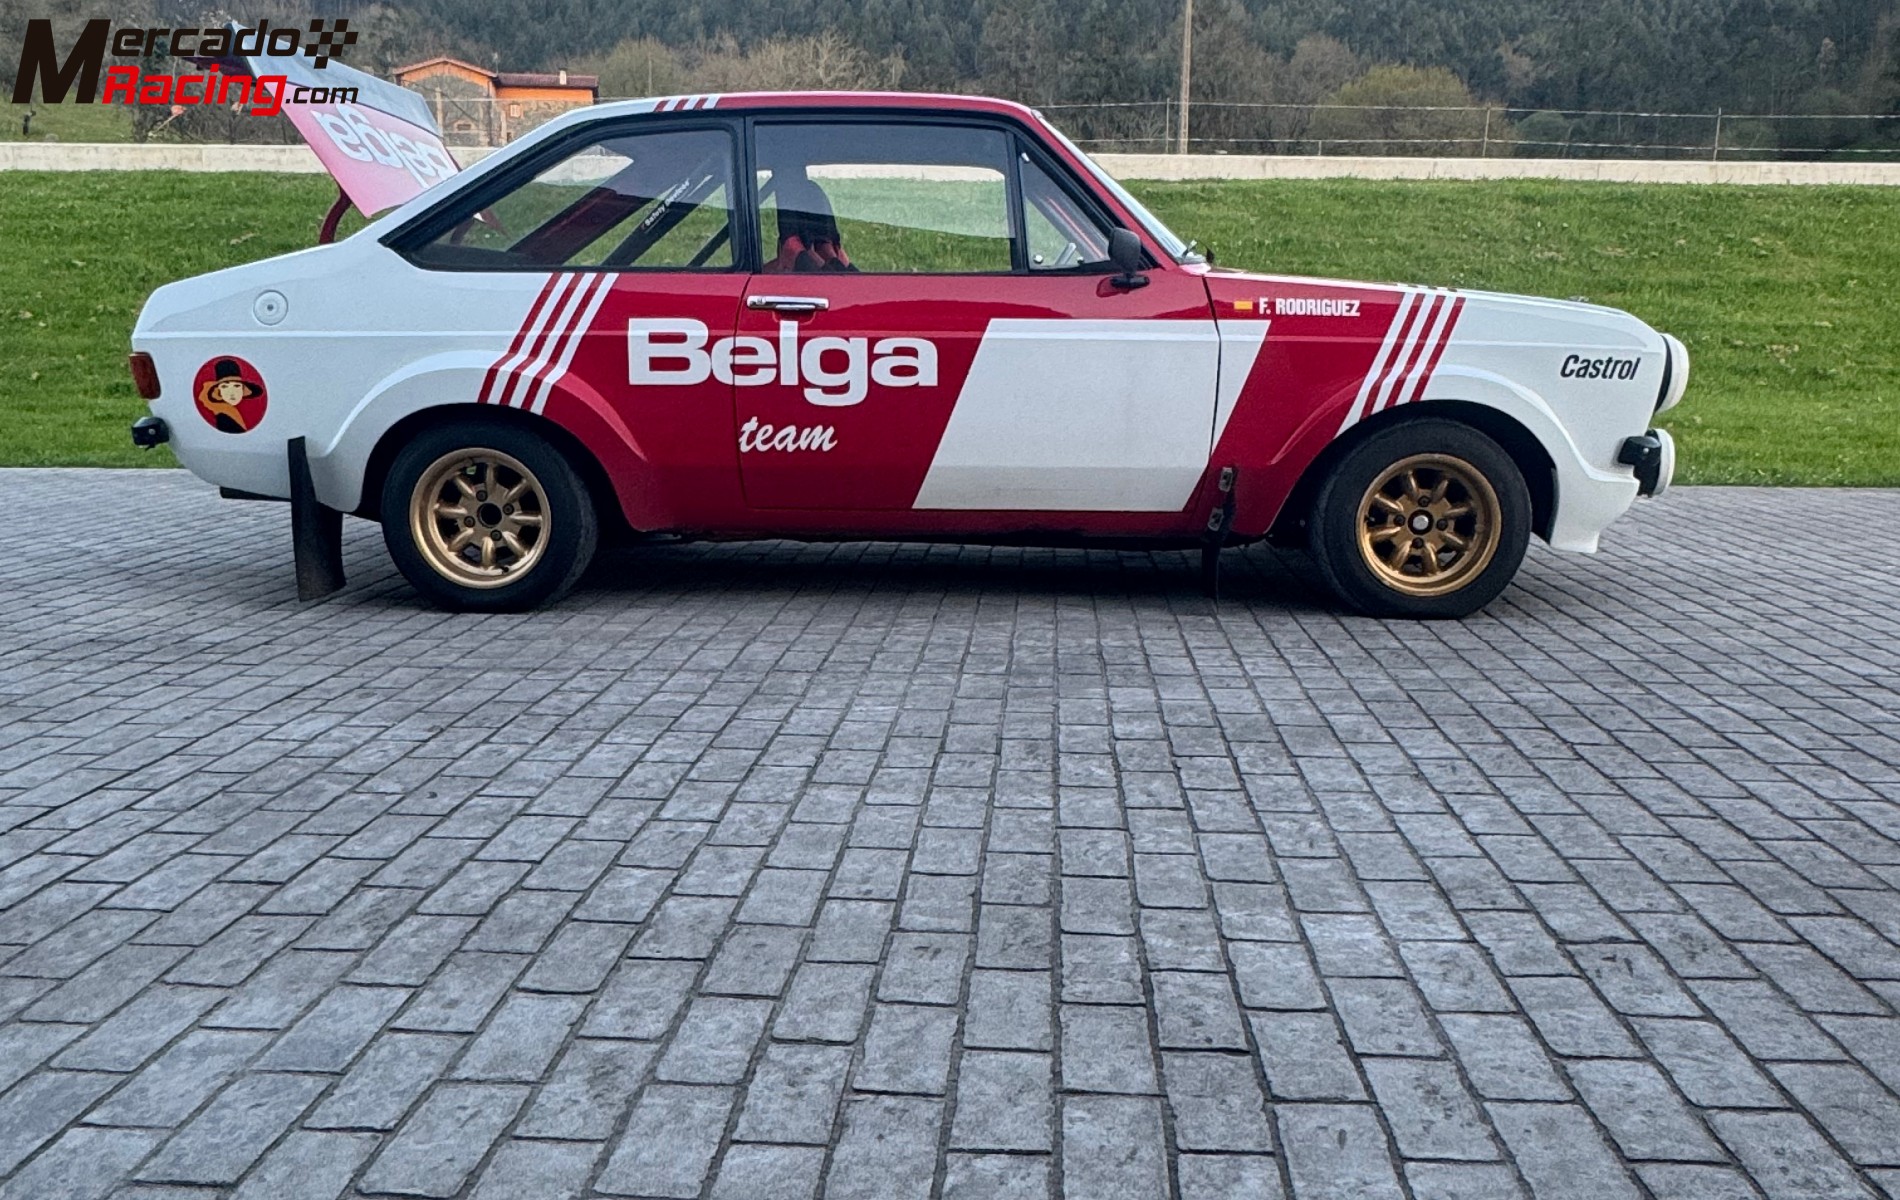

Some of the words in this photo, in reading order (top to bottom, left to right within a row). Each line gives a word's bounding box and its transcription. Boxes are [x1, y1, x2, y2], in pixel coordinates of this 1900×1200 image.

[644, 204, 666, 226] Safety
[1259, 297, 1271, 315] F.
[1275, 298, 1360, 317] RODRIGUEZ
[628, 318, 938, 407] Belga
[1560, 354, 1641, 381] Castrol
[739, 416, 837, 453] team
